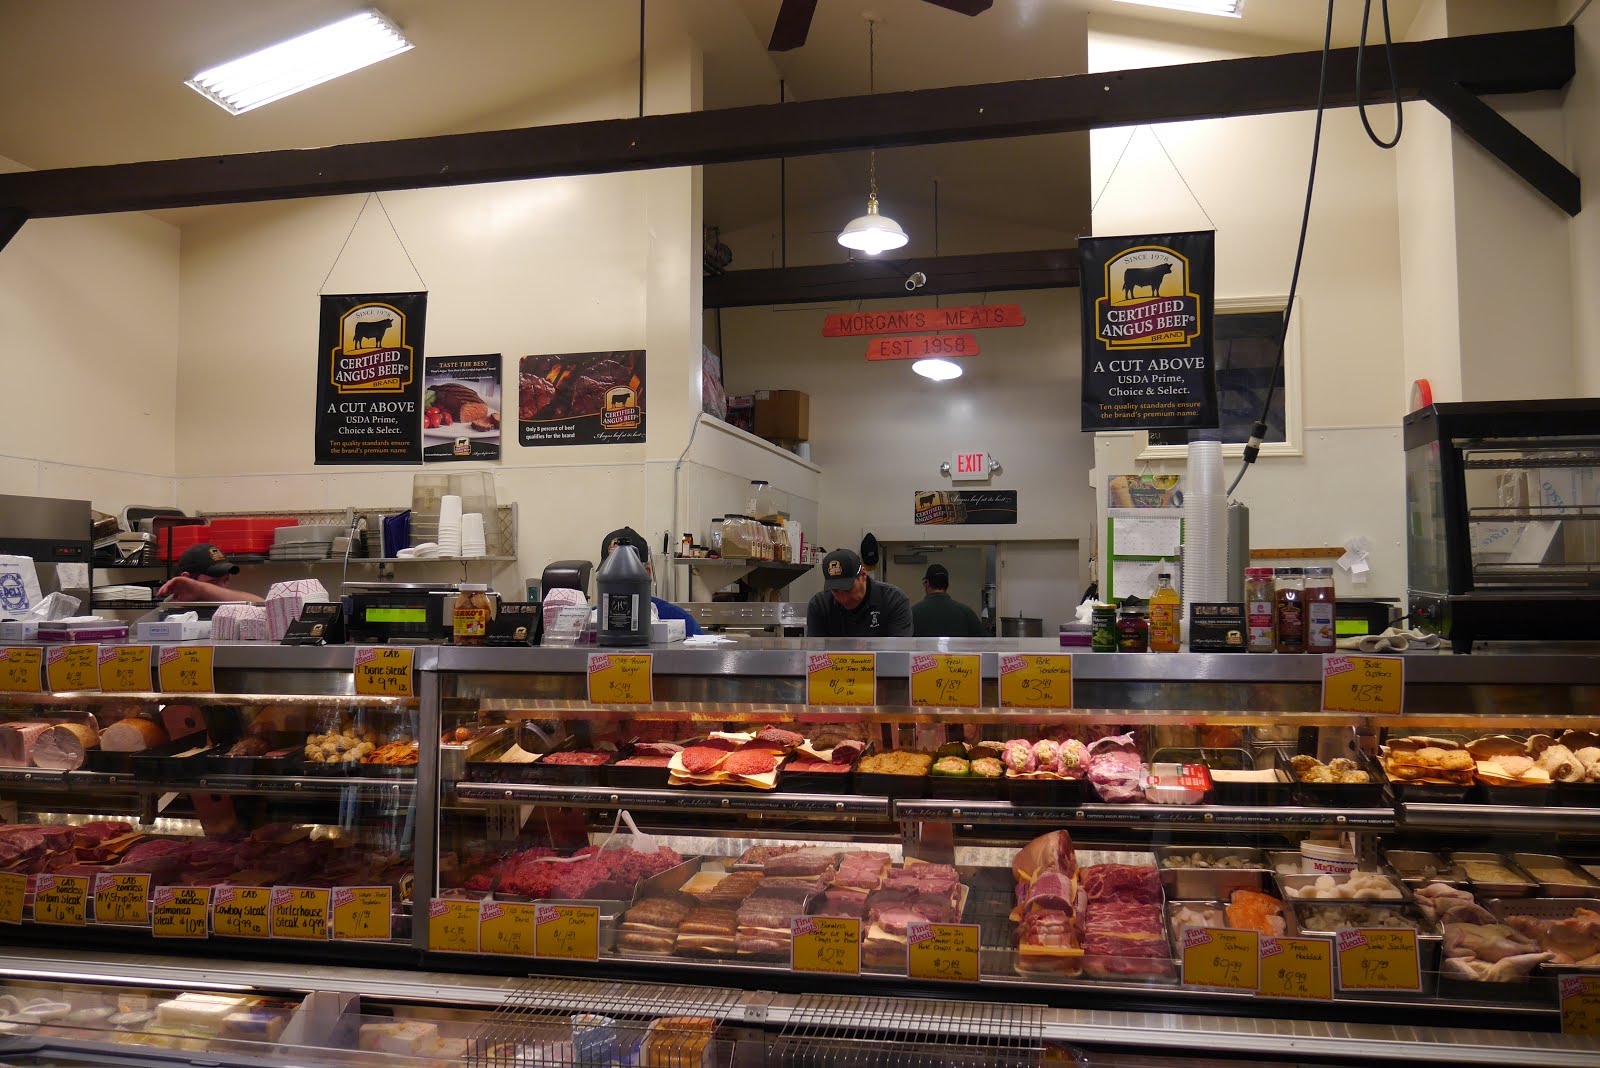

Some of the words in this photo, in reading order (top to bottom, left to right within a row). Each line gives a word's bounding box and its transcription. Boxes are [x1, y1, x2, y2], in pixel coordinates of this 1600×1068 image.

[1151, 253, 1169, 261] 1978
[1107, 300, 1184, 323] CERTIFIED
[839, 312, 926, 332] MORGAN'S
[945, 308, 1005, 326] MEATS
[1102, 320, 1153, 337] ANGUS
[1151, 331, 1183, 342] BRAND
[923, 338, 966, 354] 1958
[340, 351, 400, 370] CERTIFIED
[1093, 362, 1105, 372] A
[1109, 360, 1143, 372] CUT
[1148, 357, 1205, 371] ABOVE
[336, 368, 375, 383] ANGUS
[1118, 375, 1149, 384] USDA
[1152, 374, 1185, 384] Prime,
[373, 379, 398, 388] BRAND
[1109, 388, 1143, 396] Choice
[1146, 387, 1155, 396] &
[1157, 386, 1190, 395] Select.
[328, 403, 337, 413] A
[340, 403, 367, 413] CUT
[370, 402, 415, 413] ABOVE
[1114, 402, 1139, 410] quality
[604, 408, 636, 419] CERTIFIED
[346, 416, 370, 424] USDA
[372, 416, 398, 425] Prime,
[603, 416, 623, 426] ANGUS
[338, 426, 366, 434] Choice
[376, 425, 402, 434] Select.
[958, 454, 984, 473] EXIT
[384, 650, 400, 658] CAB
[809, 654, 827, 664] Fine
[913, 655, 931, 664] Fine
[591, 655, 609, 665] Fine
[1002, 655, 1021, 665] Fine
[1327, 656, 1346, 667] Fine
[386, 665, 408, 676] Steak
[912, 660, 938, 673] Meats
[1000, 661, 1028, 673] Meats
[61, 879, 75, 887] CAB
[181, 890, 196, 898] CAB
[61, 894, 82, 906] Steak
[215, 904, 243, 919] Cowboy
[244, 904, 267, 916] Steak
[276, 905, 323, 917] Porterhouse
[483, 904, 499, 913] Fine
[538, 906, 555, 916] Fine
[275, 917, 299, 928] Steak
[795, 917, 813, 927] Fine
[912, 925, 930, 934] Fine
[1185, 929, 1204, 939] Fine
[1183, 935, 1212, 947] Meats
[1340, 930, 1360, 941] Fine
[1223, 942, 1250, 953] Salmon
[1339, 936, 1367, 951] Meats
[1296, 953, 1323, 961] Haddock
